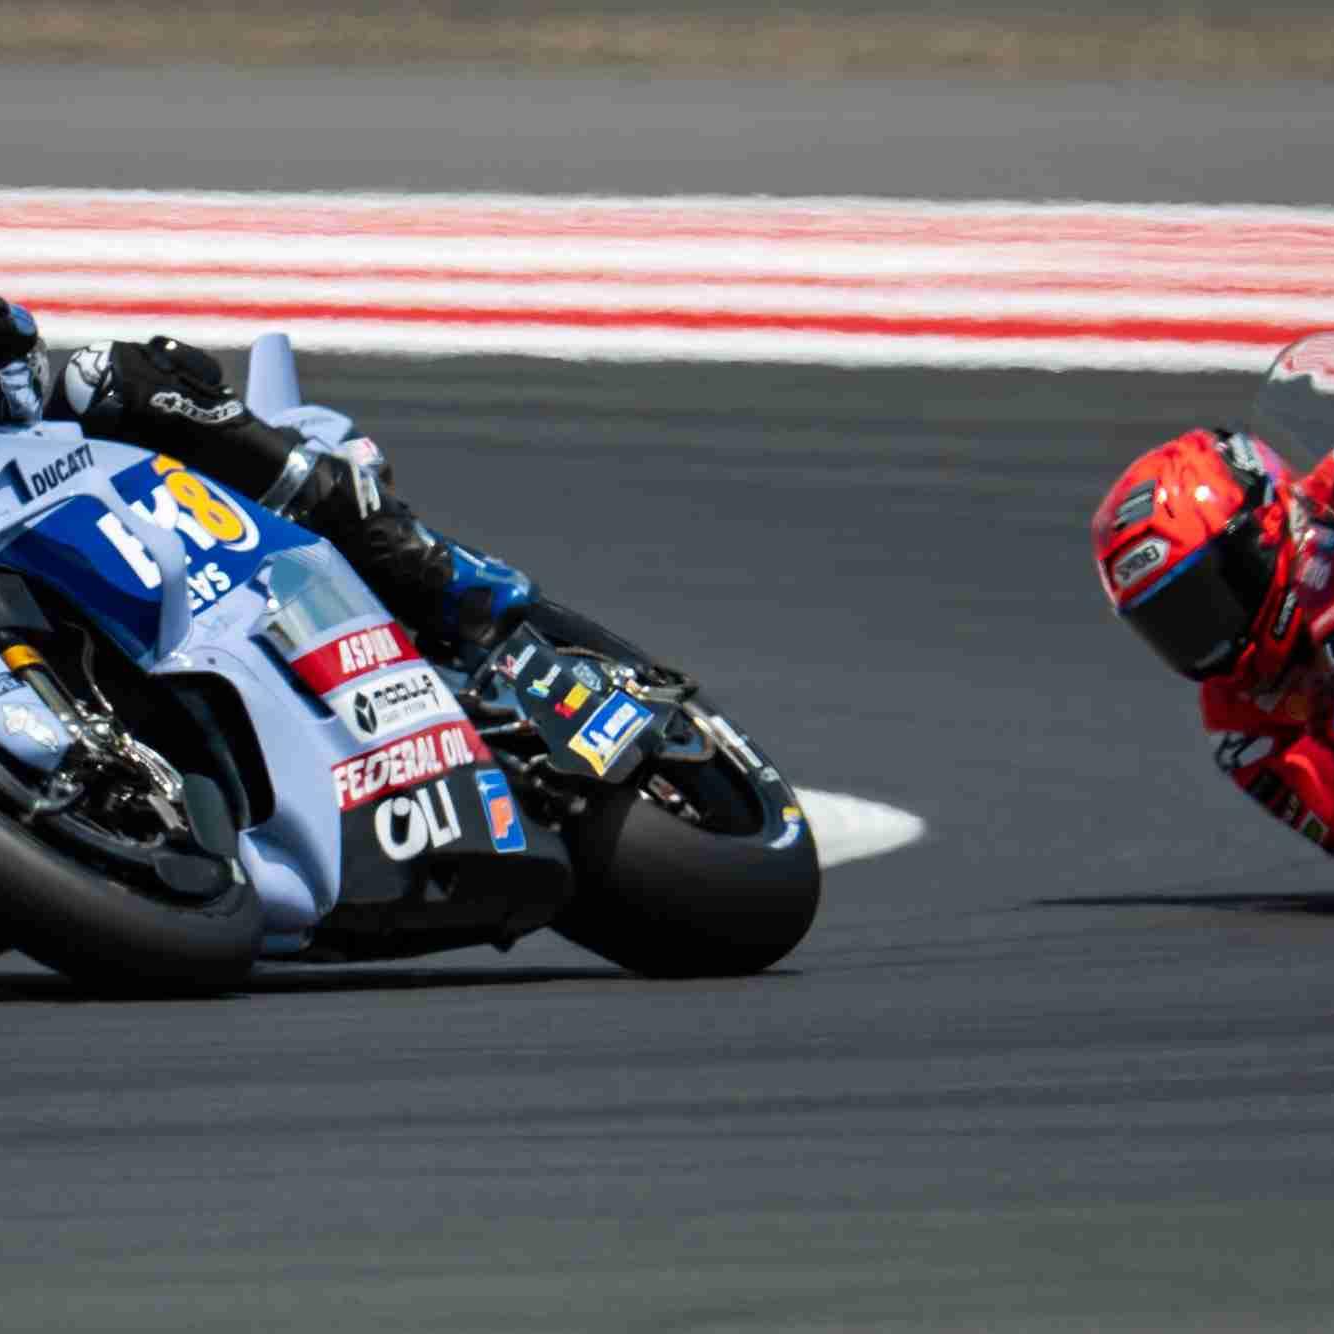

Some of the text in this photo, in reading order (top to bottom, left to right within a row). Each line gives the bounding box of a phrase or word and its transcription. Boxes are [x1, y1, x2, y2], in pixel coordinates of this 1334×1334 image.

[32, 443, 95, 498] DUCATI
[331, 727, 475, 809] FEDERAL OIL
